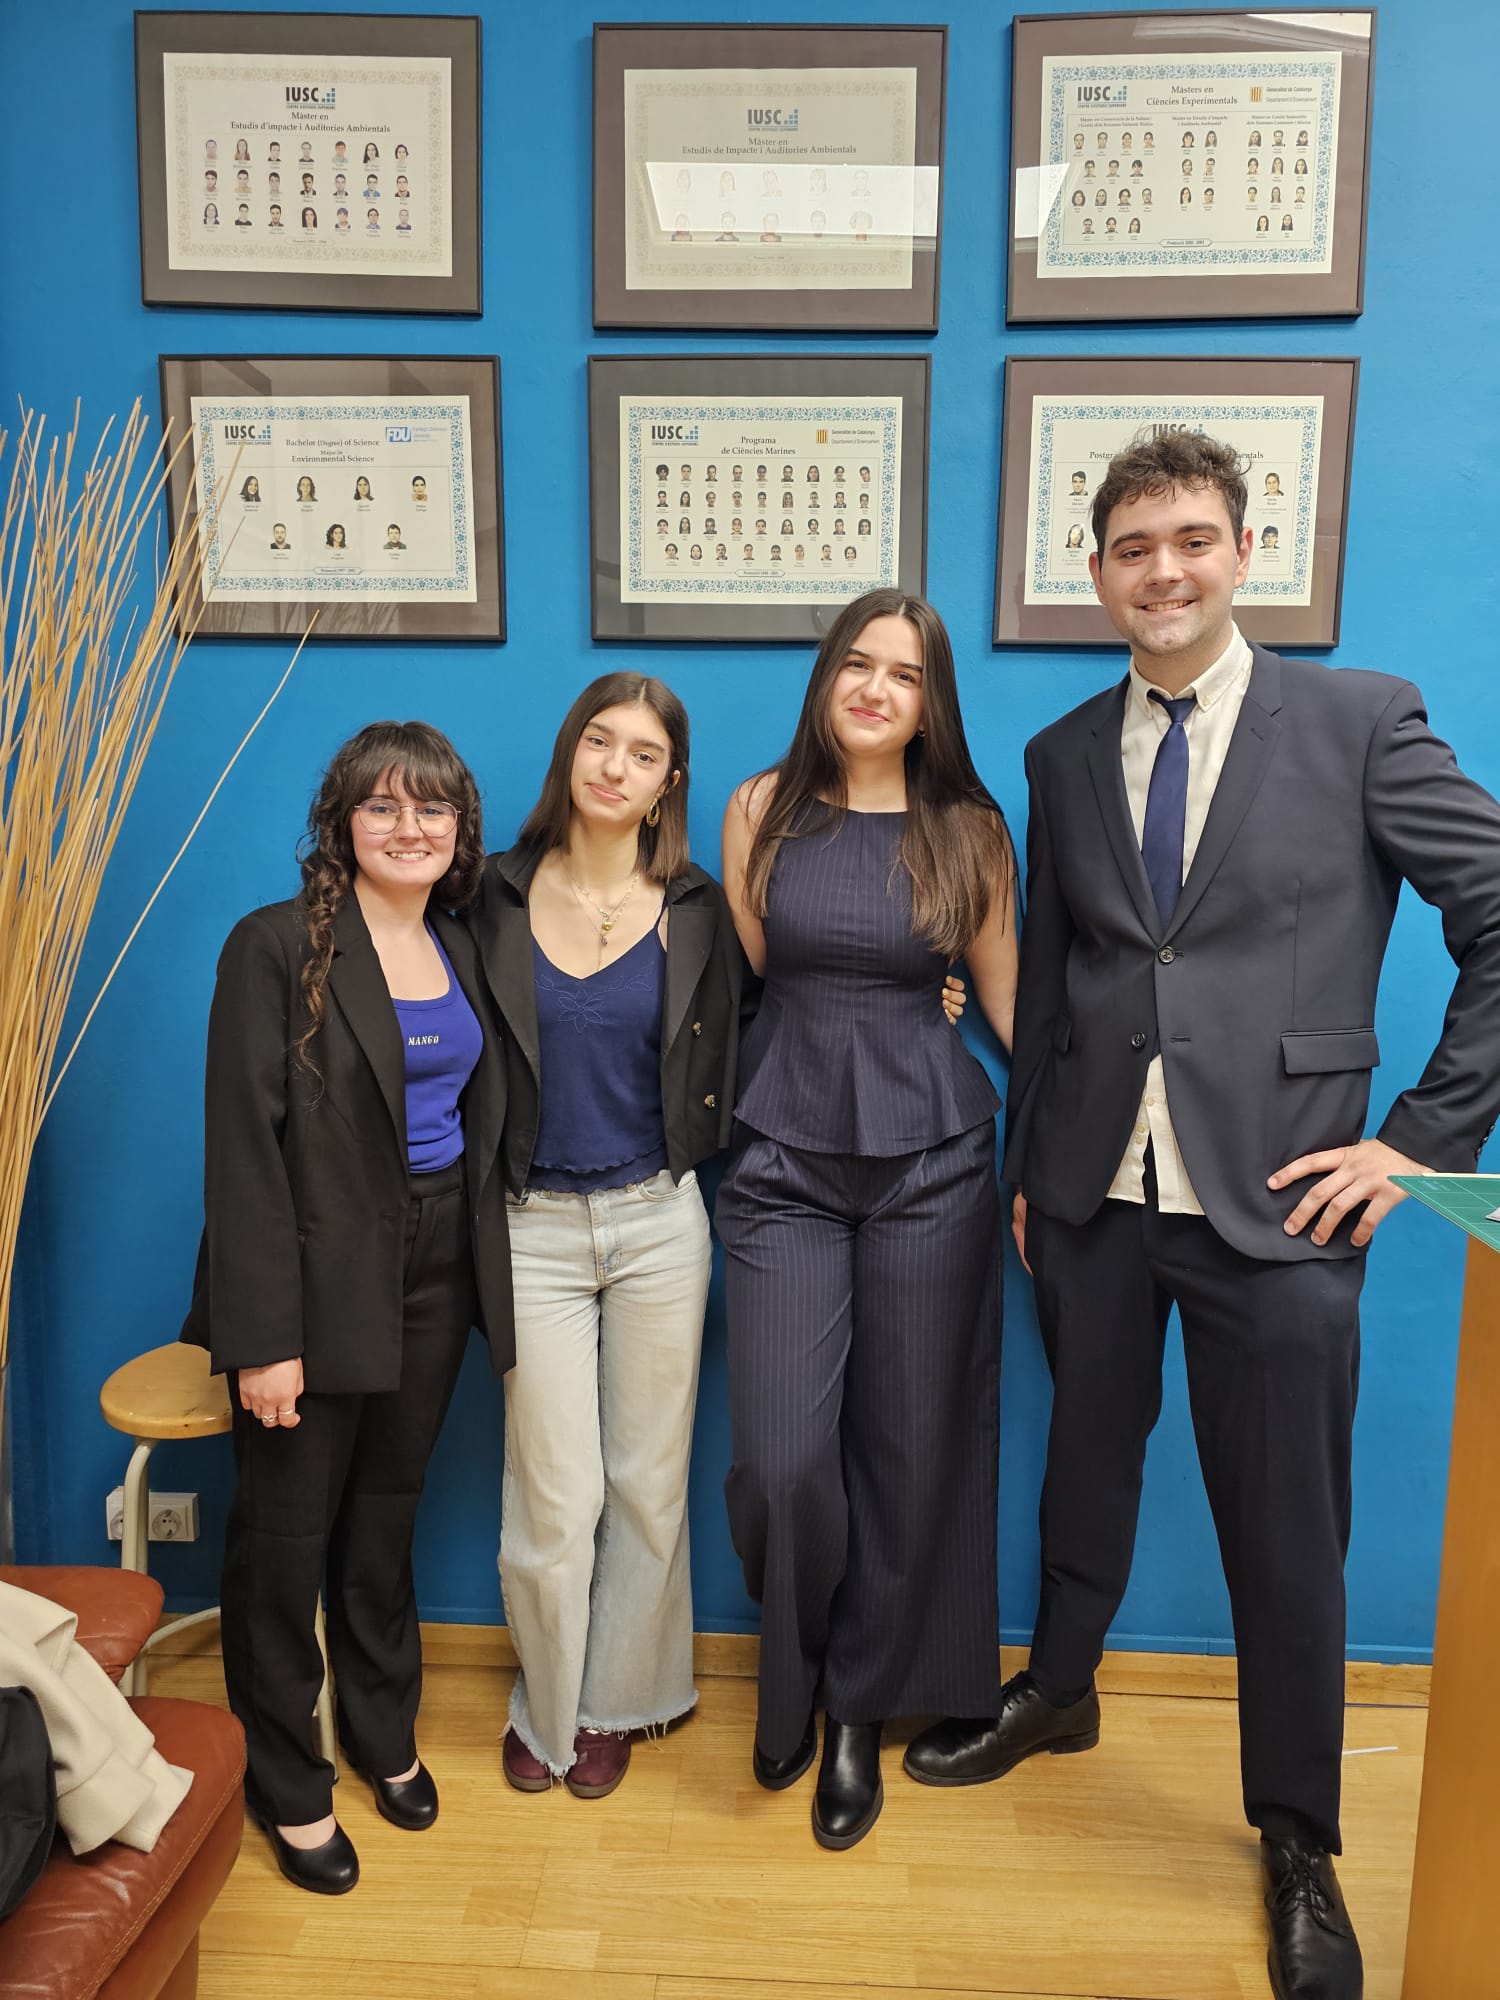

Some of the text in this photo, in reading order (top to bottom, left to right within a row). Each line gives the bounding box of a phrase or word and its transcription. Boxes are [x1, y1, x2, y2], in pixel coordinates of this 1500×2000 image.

[286, 86, 319, 102] IUSC
[1077, 86, 1111, 102] IUSC
[1182, 96, 1238, 107] Experimentals
[319, 113, 329, 121] en
[747, 109, 782, 125] IUSC
[231, 121, 259, 130] Estudis
[260, 121, 298, 132] d'impacte
[304, 123, 344, 132] Auditories
[346, 123, 391, 133] Ambientals
[682, 146, 712, 155] Estudis
[713, 146, 724, 154] de
[726, 146, 757, 156] Impacte
[765, 146, 808, 154] Auditories
[810, 145, 857, 154] Ambientals
[225, 425, 256, 439] IUSC
[652, 425, 683, 440] IUSC
[741, 436, 776, 445] Programa
[721, 446, 731, 454] de
[765, 447, 796, 455] Marines
[292, 455, 375, 463] Environmental Science
[408, 1035, 440, 1046] MANGO
